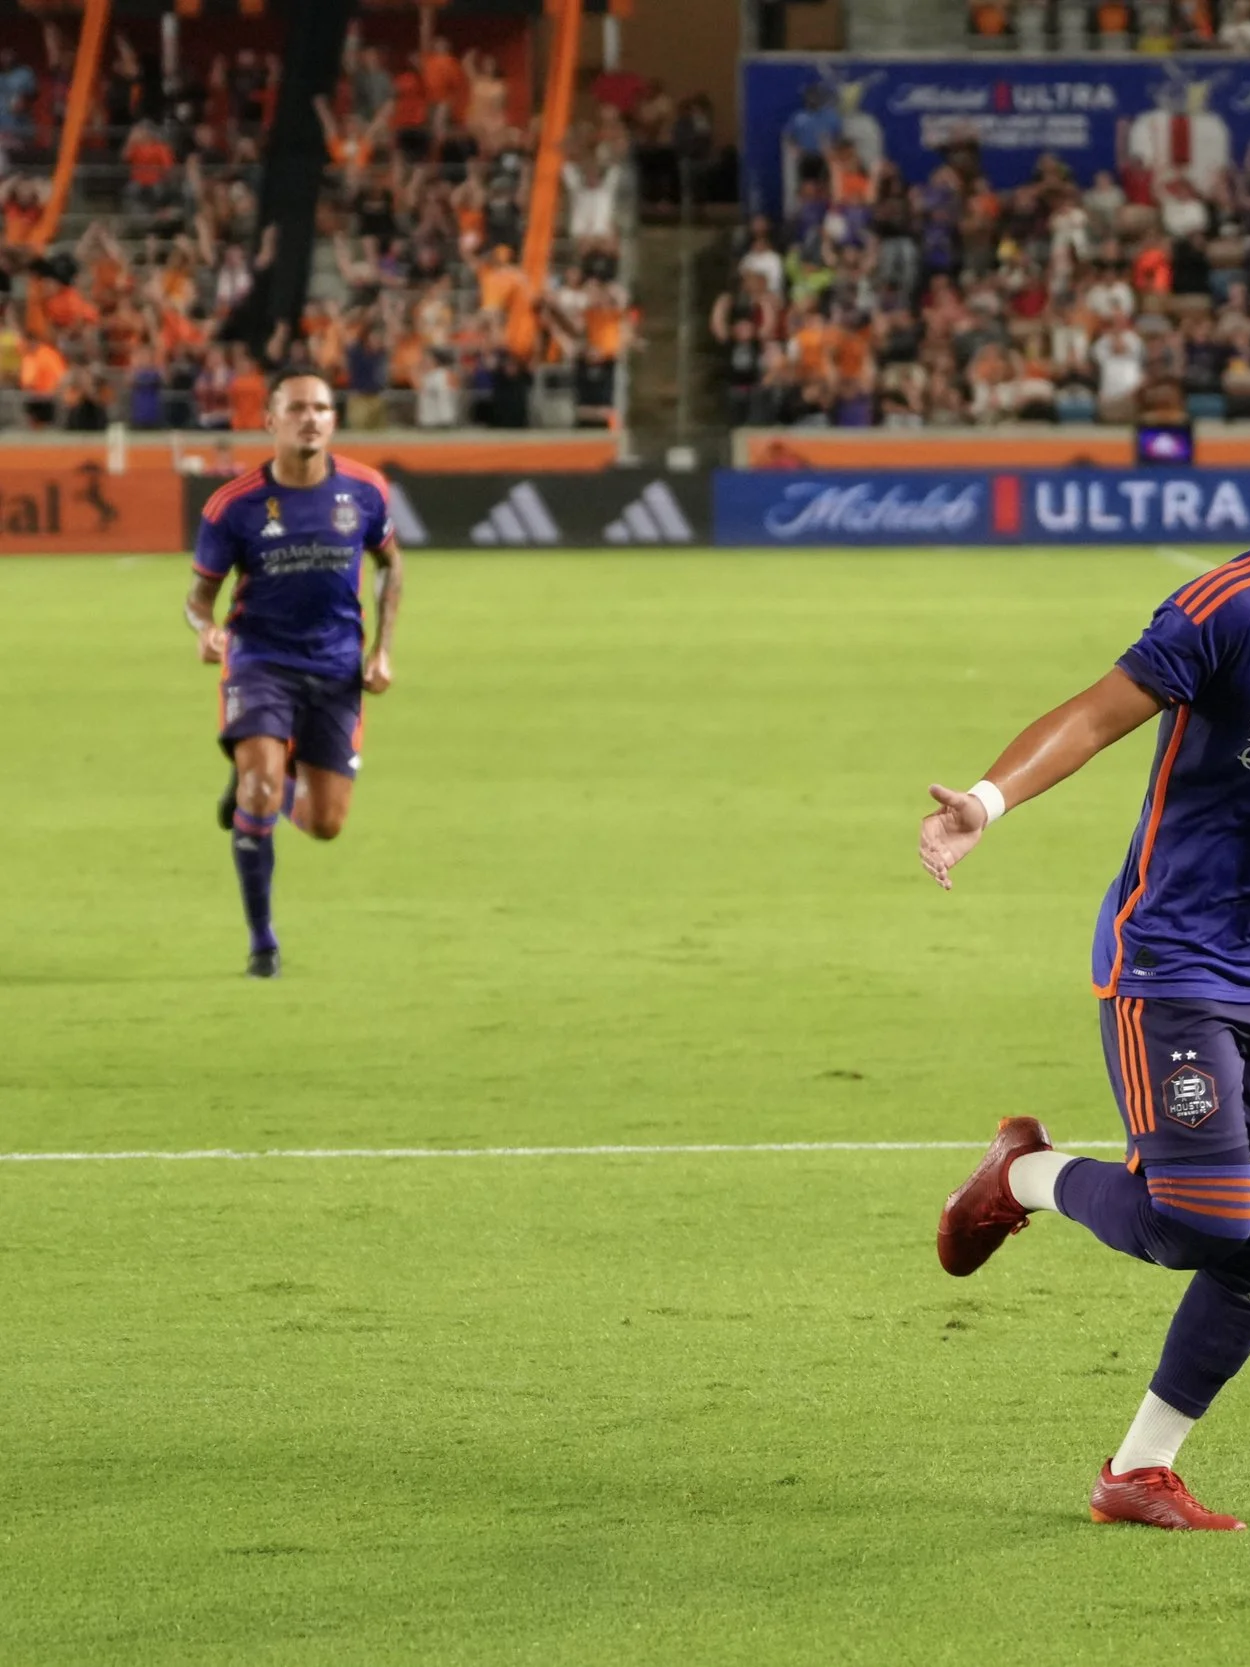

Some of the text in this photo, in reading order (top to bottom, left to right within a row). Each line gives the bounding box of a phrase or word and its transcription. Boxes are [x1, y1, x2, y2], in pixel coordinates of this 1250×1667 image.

[1012, 82, 1116, 111] ULTRA
[0, 480, 61, 534] al
[1034, 480, 1250, 532] ULTRA
[1169, 1100, 1213, 1114] HOUSTON
